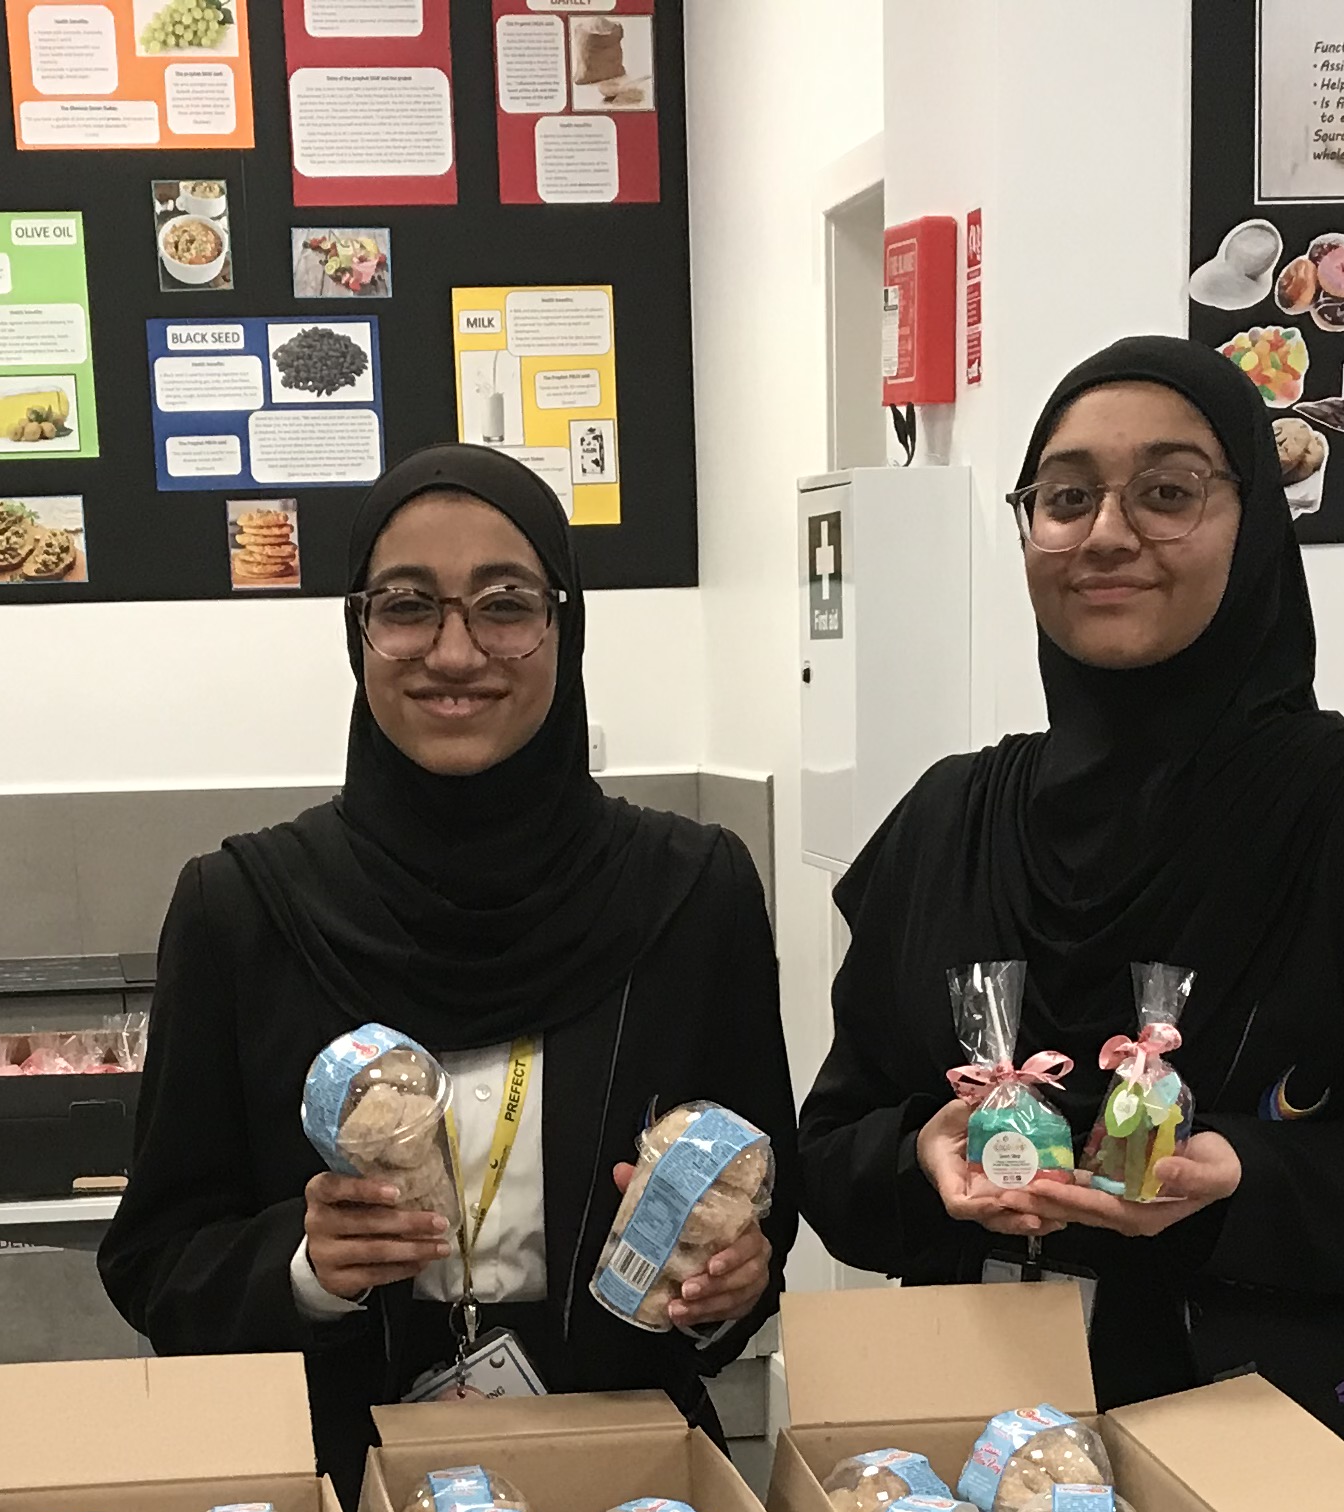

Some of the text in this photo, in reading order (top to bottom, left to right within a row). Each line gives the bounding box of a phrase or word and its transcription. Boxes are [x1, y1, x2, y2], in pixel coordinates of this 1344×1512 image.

[1321, 97, 1329, 108] Is
[1321, 112, 1334, 123] to
[15, 226, 72, 238] OLIVE OIL
[467, 317, 494, 328] MILK
[172, 331, 240, 344] BLACK SEED
[505, 1059, 526, 1122] PREFECT
